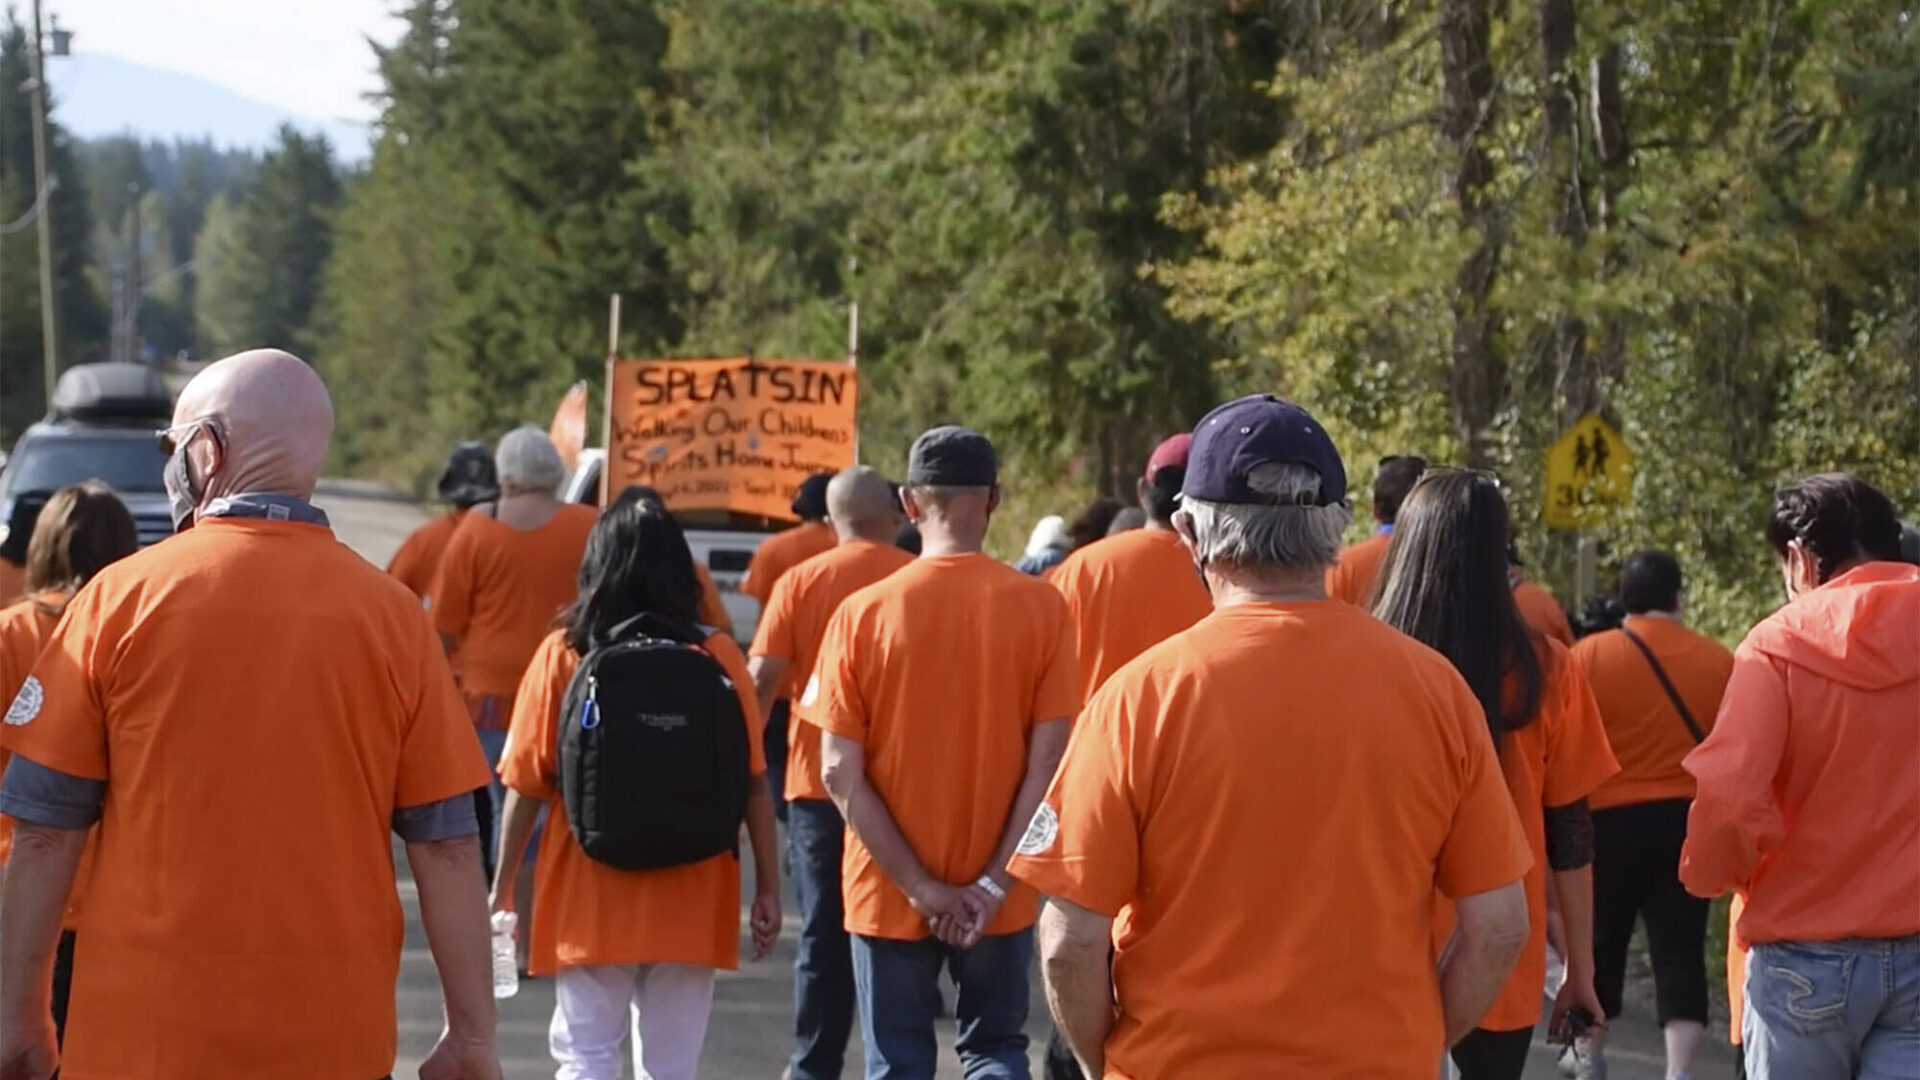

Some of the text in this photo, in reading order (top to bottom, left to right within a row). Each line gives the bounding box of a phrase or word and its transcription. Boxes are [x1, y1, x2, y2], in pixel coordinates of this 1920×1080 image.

[637, 366, 846, 405] SPLATSIN
[703, 407, 750, 437] Our
[622, 444, 709, 482] Spirits
[716, 438, 774, 469] Home
